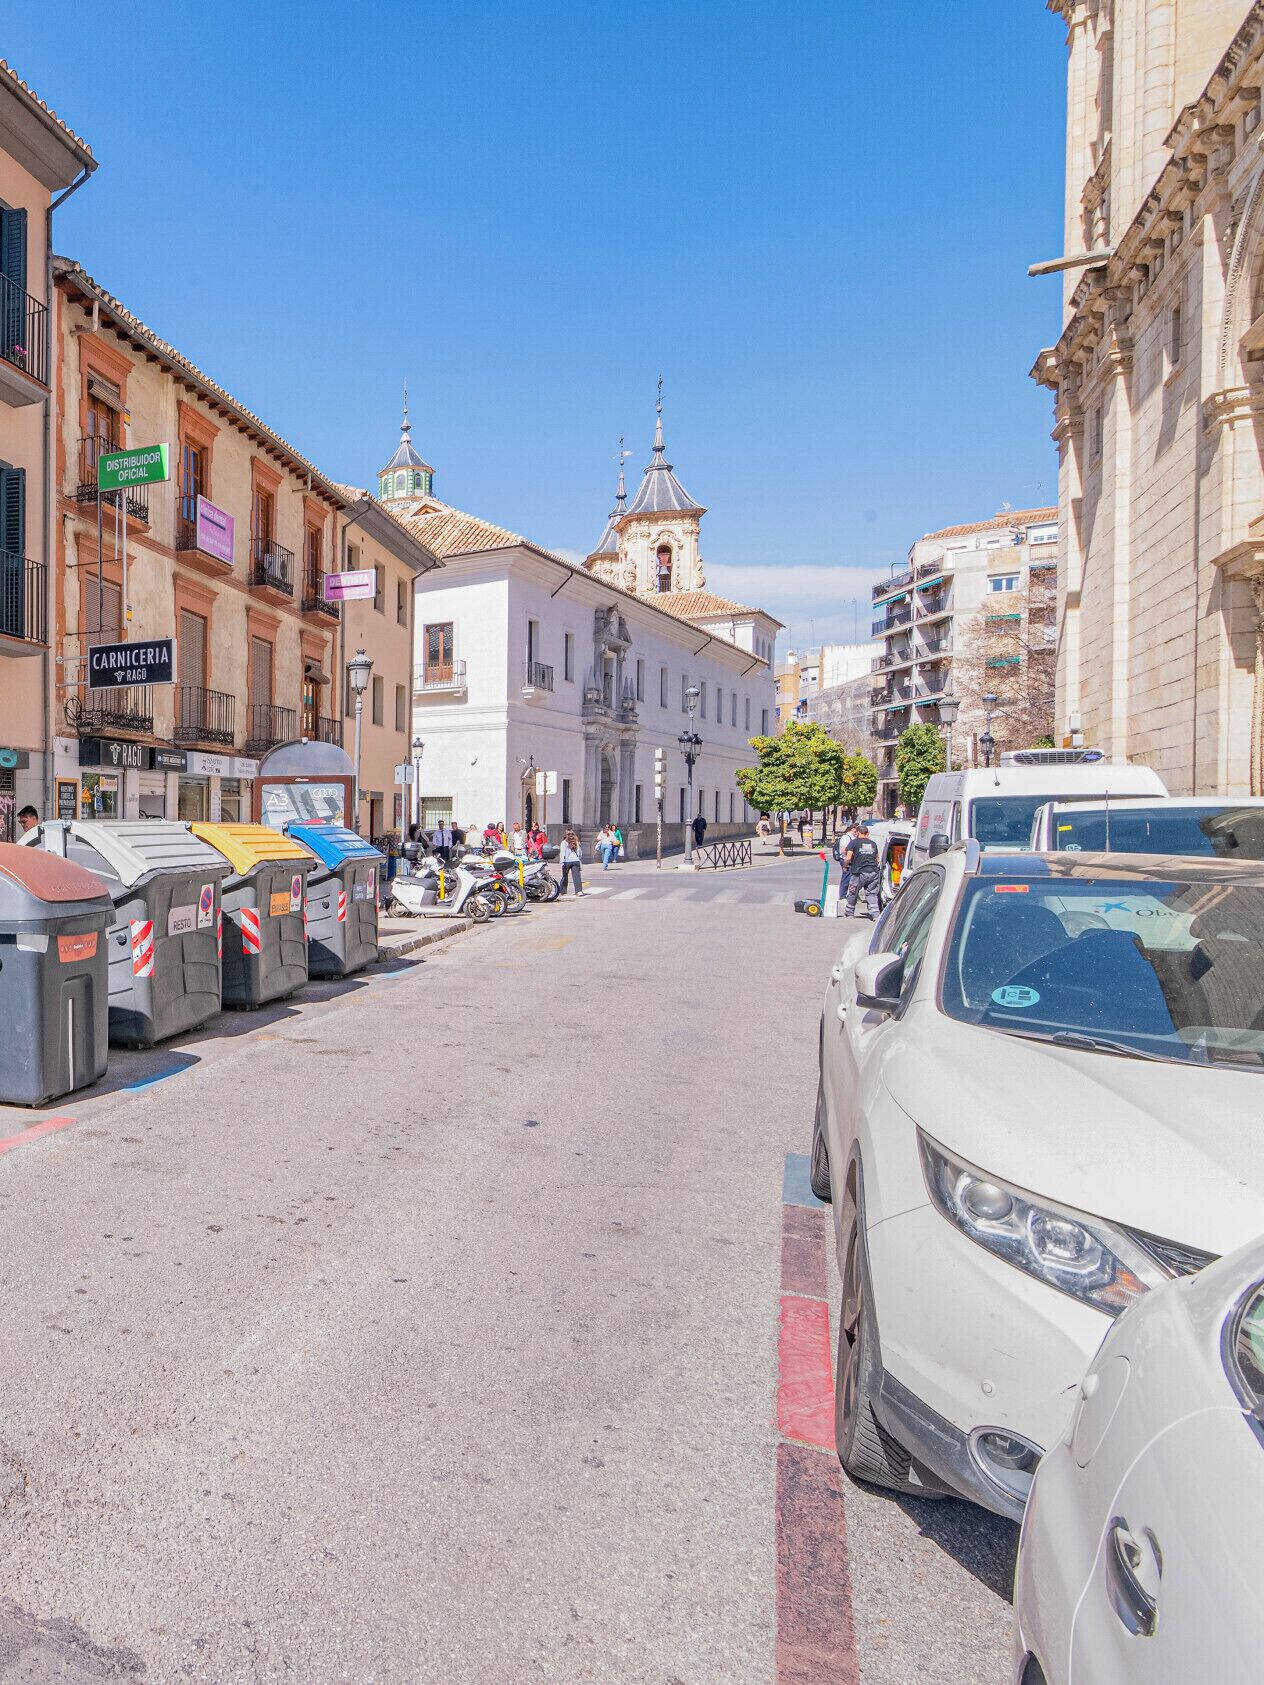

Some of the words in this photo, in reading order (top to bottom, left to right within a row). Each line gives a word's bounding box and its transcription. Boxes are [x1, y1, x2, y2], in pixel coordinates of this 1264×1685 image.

[106, 452, 161, 471] DISTRIBUIDOR
[118, 467, 148, 481] OFICIAL
[93, 647, 169, 670] CARNICERIA
[267, 793, 288, 806] A3
[173, 918, 192, 931] RESTO
